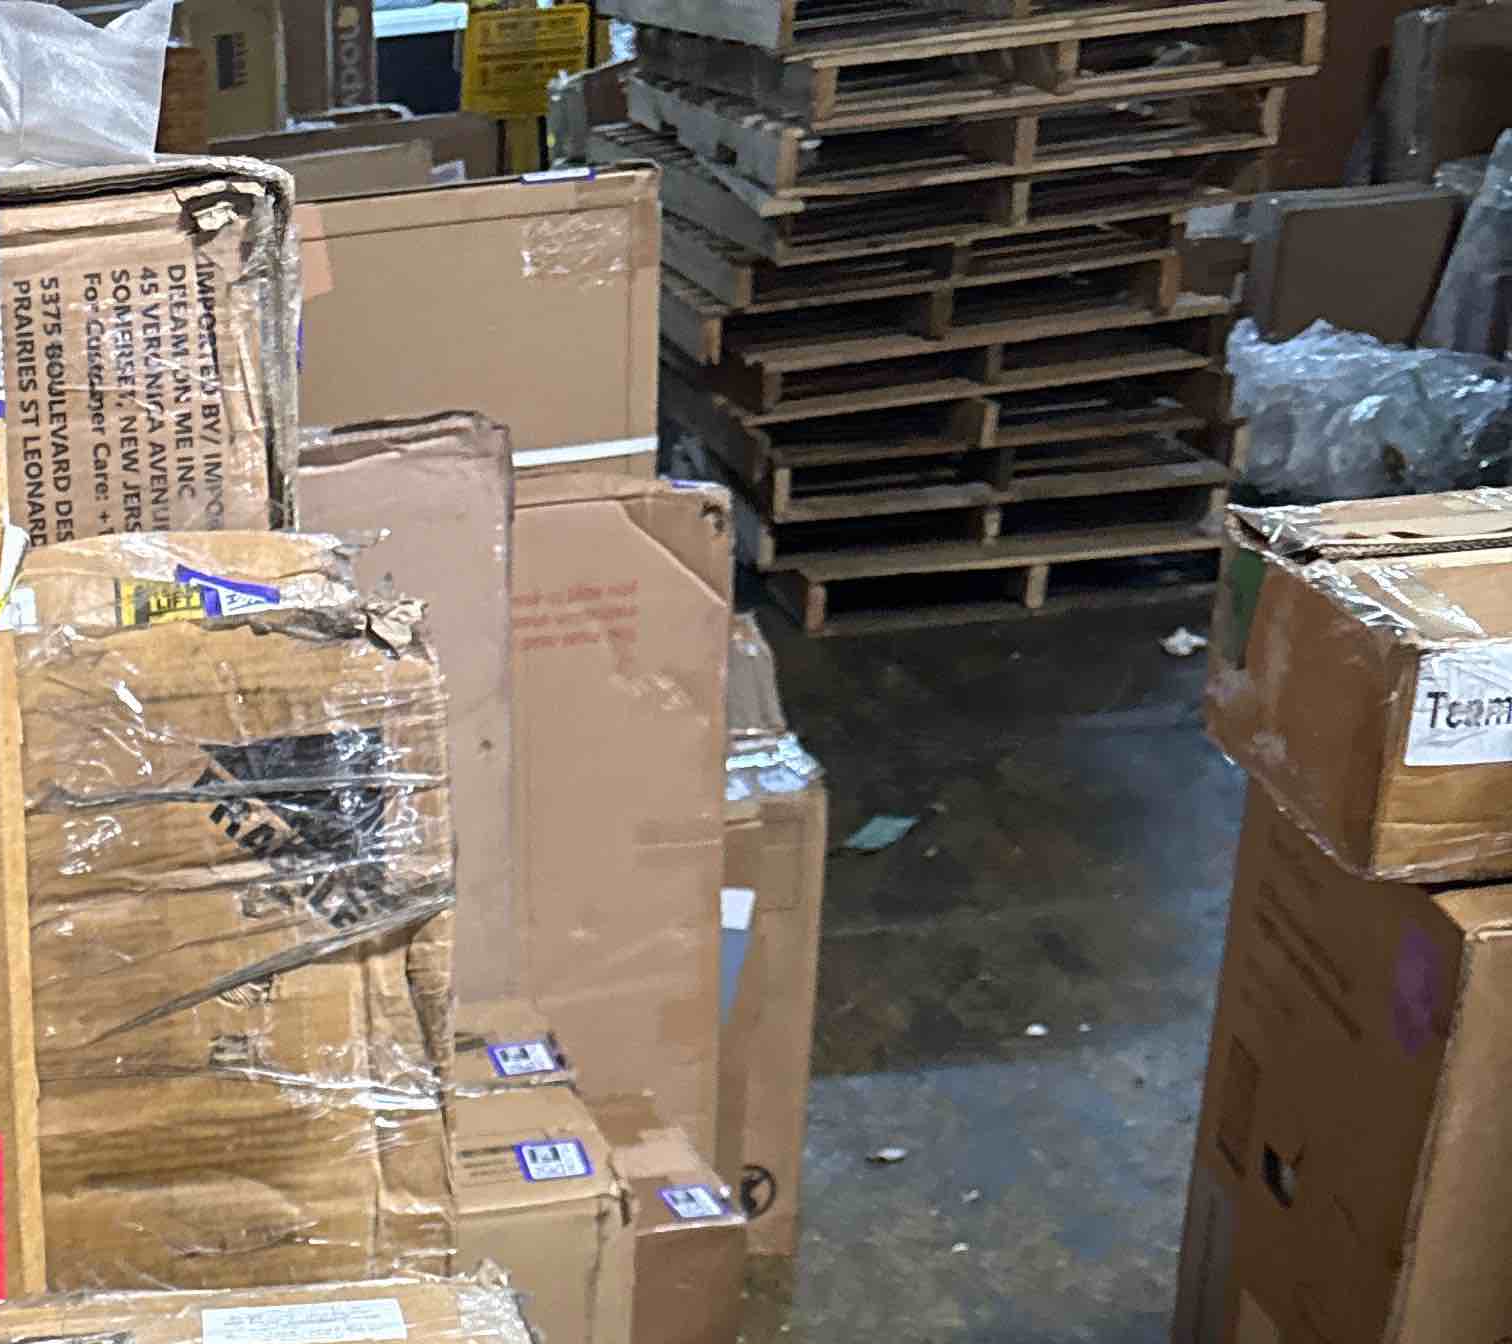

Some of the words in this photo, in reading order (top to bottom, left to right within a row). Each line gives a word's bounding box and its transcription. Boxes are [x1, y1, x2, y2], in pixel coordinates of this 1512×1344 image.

[139, 265, 159, 296] 45
[39, 277, 62, 336] 5375
[12, 280, 38, 392] PRAIRIES
[19, 400, 40, 427] ST
[44, 343, 72, 494] BOULEVARD
[176, 411, 194, 452] ME
[119, 415, 139, 472] NEW
[92, 442, 111, 502] Care:
[177, 456, 195, 498] INC
[54, 499, 74, 543] DES
